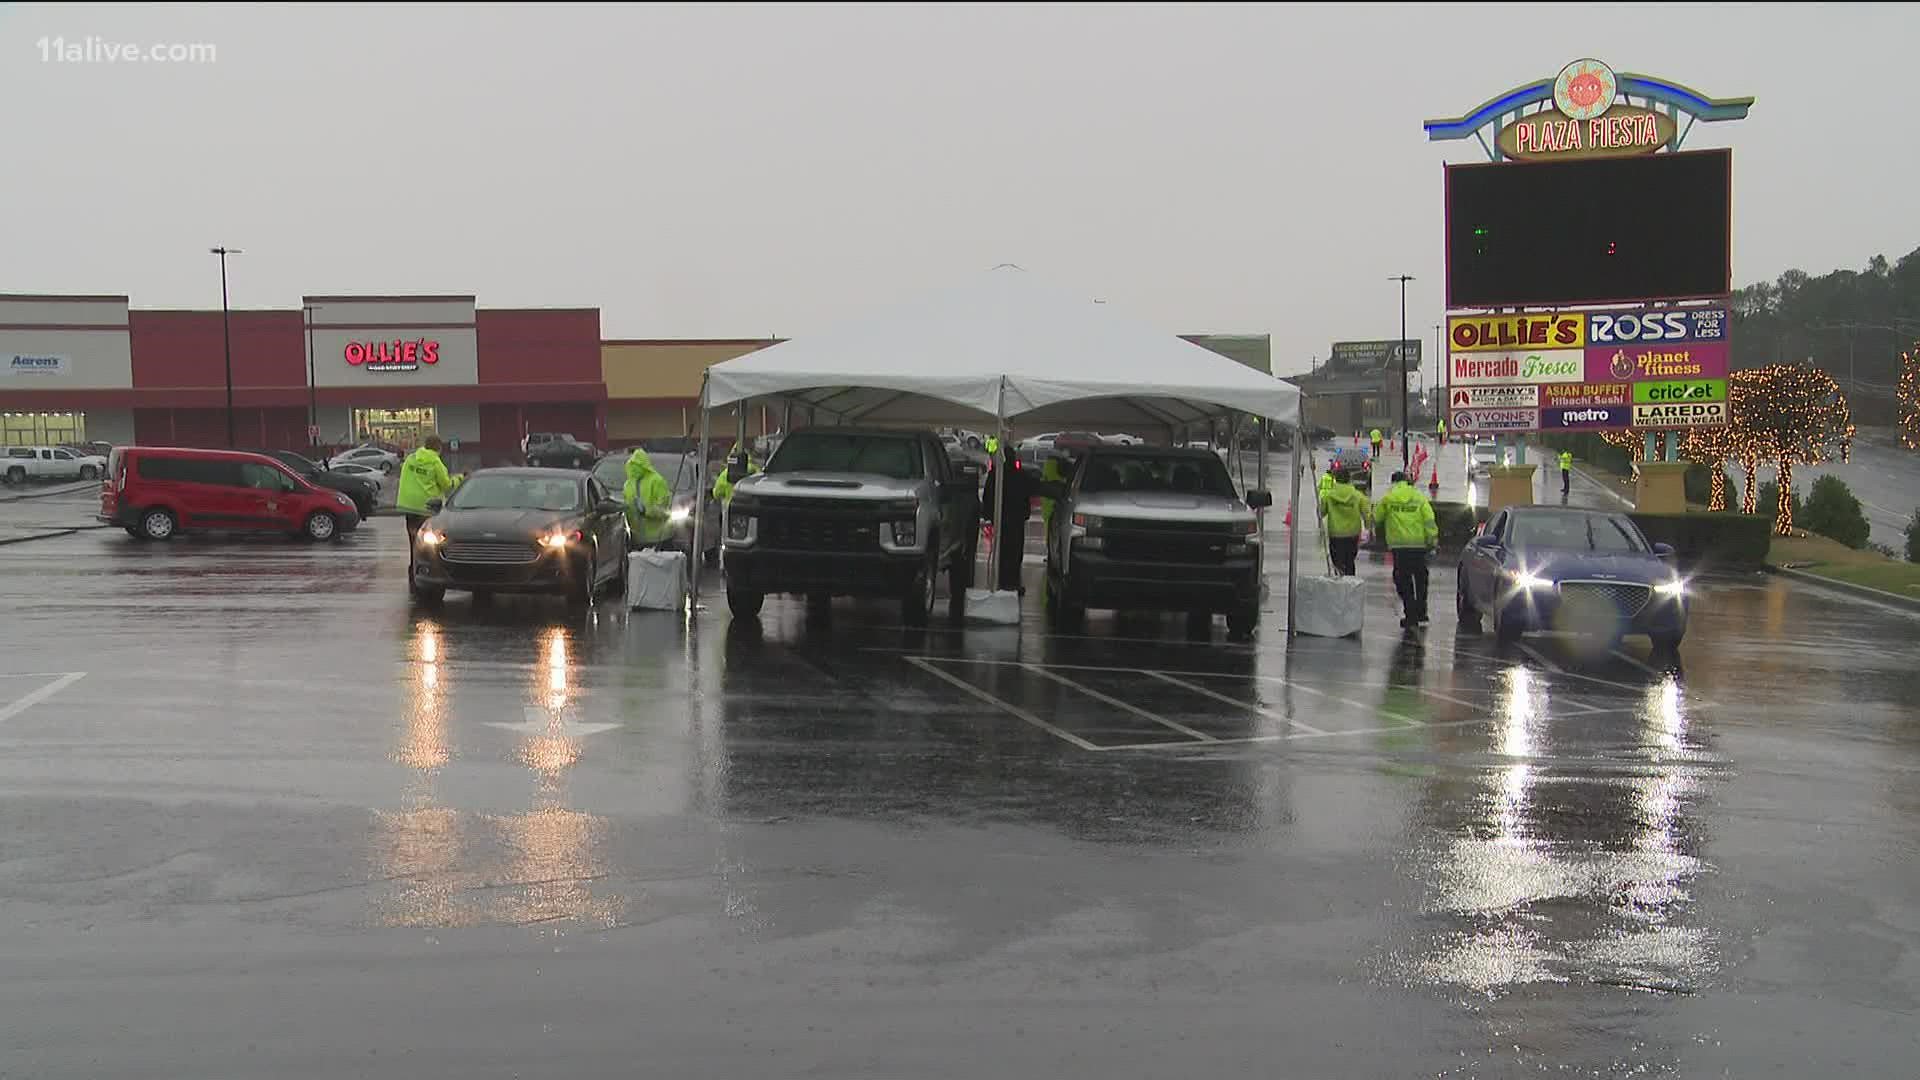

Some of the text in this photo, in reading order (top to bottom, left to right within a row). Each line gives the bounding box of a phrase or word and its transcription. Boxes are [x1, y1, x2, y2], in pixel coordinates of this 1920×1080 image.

[1517, 114, 1657, 152] PLAZA FIESTA
[1692, 310, 1725, 320] DRESS
[1591, 312, 1687, 341] ROSS
[1697, 319, 1719, 329] FOR
[1695, 328, 1721, 338] LESS
[1637, 351, 1690, 367] planet
[1455, 355, 1577, 378] Mercado Fresco
[1645, 362, 1701, 376] fitness
[1472, 387, 1535, 396] TIFFANY'S
[1546, 383, 1627, 397] ASIAN BUFFET
[1649, 384, 1712, 399] cricket
[1552, 395, 1624, 406] Hibachi Sushi
[1475, 411, 1535, 422] YVONNE'S
[1563, 409, 1609, 422] metro
[1638, 405, 1721, 417] LAREDO
[1636, 415, 1723, 425] WESTERN WEAR
